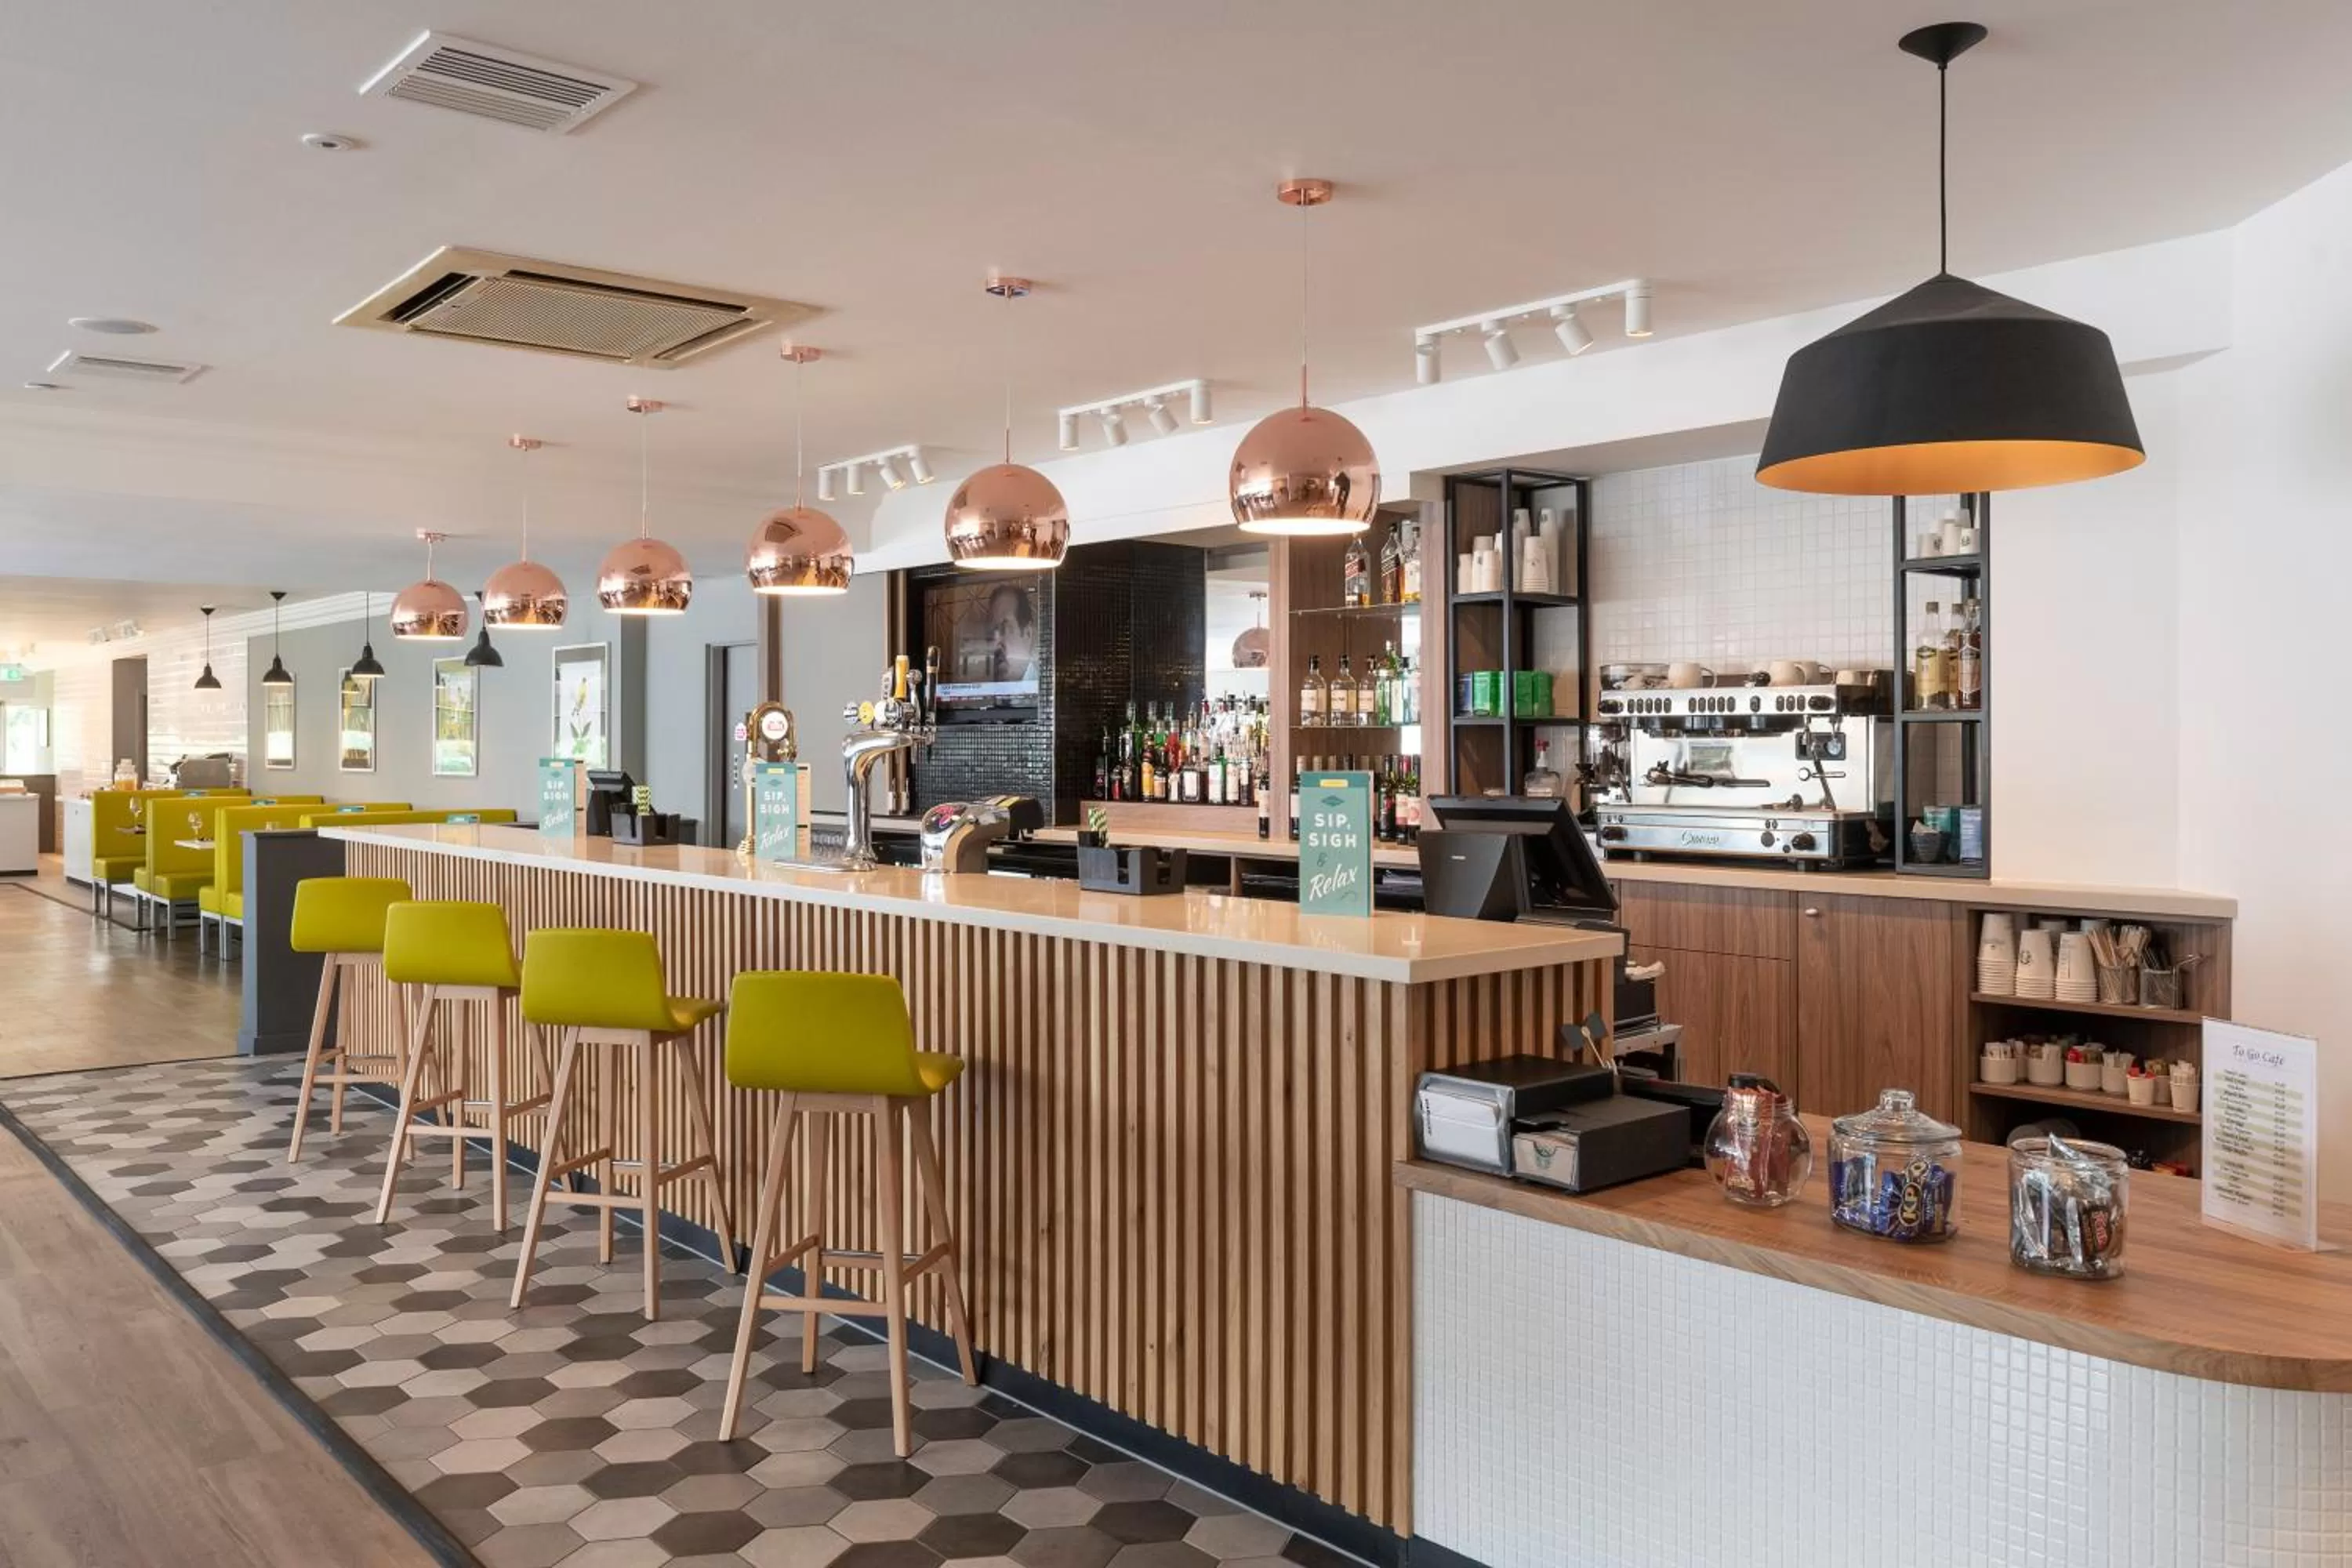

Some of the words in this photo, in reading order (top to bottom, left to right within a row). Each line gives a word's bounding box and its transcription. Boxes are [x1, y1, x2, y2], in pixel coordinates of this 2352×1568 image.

[1314, 813, 1351, 830] SIP,
[1308, 833, 1358, 848] SIGH
[1308, 863, 1359, 902] Relax
